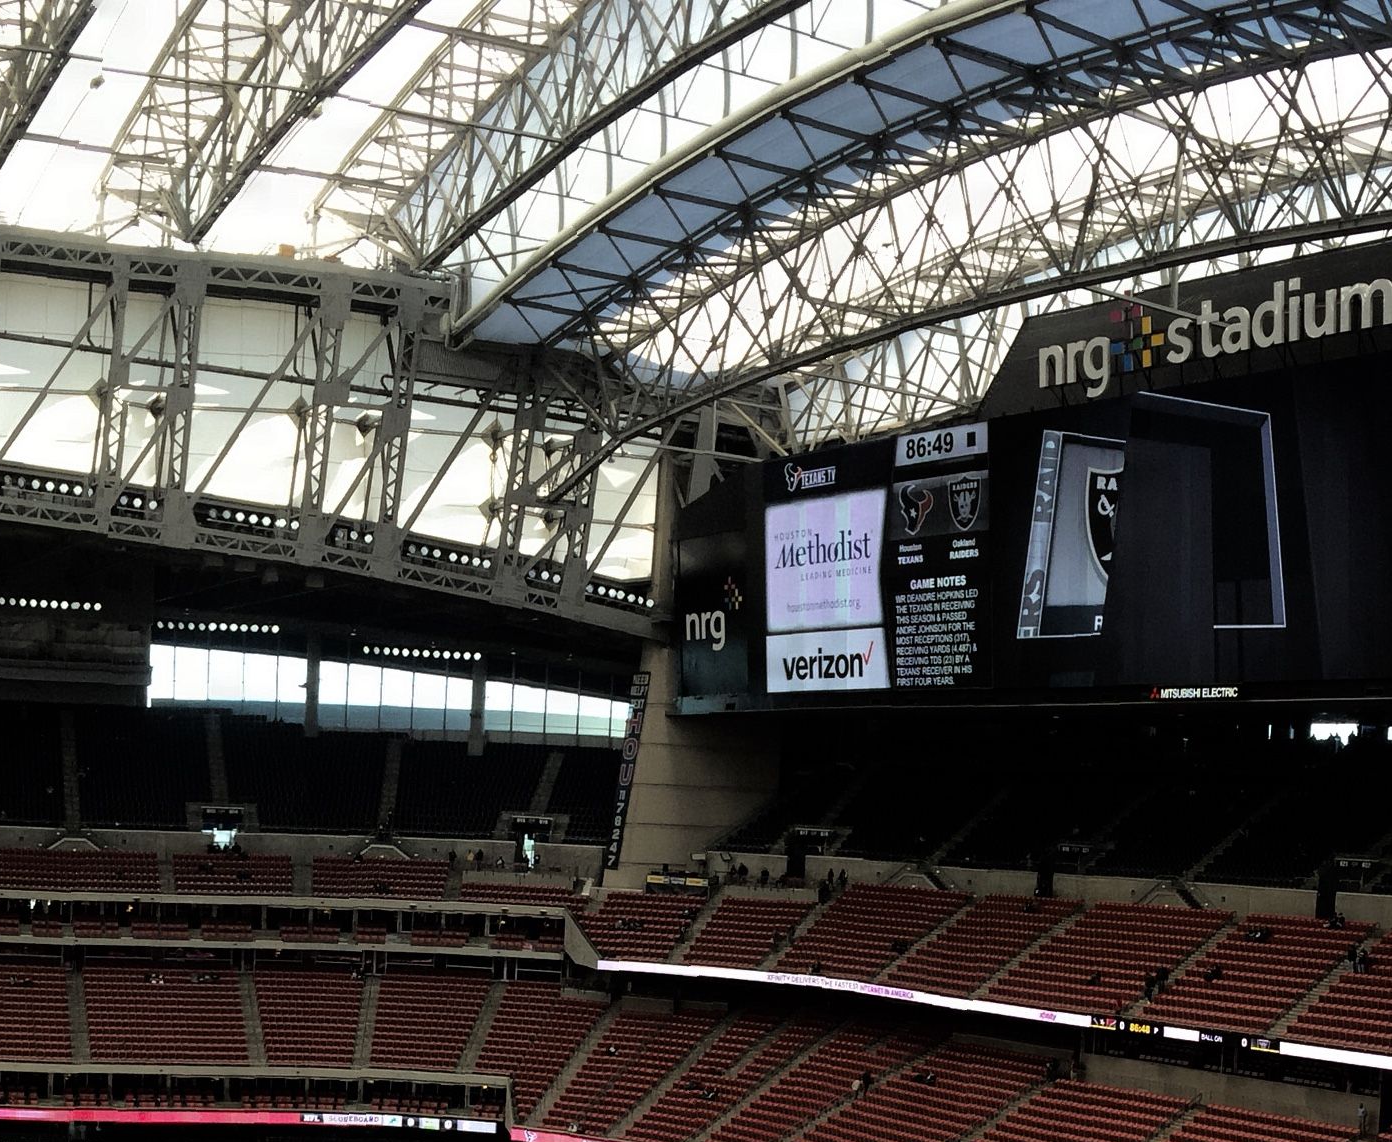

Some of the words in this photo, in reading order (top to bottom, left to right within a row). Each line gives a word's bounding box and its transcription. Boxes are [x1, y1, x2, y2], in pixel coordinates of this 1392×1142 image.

[1039, 335, 1111, 398] nrg
[1166, 276, 1392, 365] stadium
[905, 431, 955, 460] 86:49
[801, 469, 826, 487] TEXANS
[827, 467, 836, 484] TV
[774, 529, 813, 542] HOUSTON
[775, 529, 871, 569] Methodist
[949, 548, 979, 560] RAIDERS
[897, 554, 923, 565] TEXANS
[835, 565, 873, 579] MEDICINE
[910, 577, 935, 590] GAME
[937, 575, 966, 588] NOTES
[685, 610, 726, 651] nrg
[783, 648, 864, 681] verizon
[1160, 686, 1201, 699] MITSUBISHI
[1202, 686, 1238, 698] ELECTRIC
